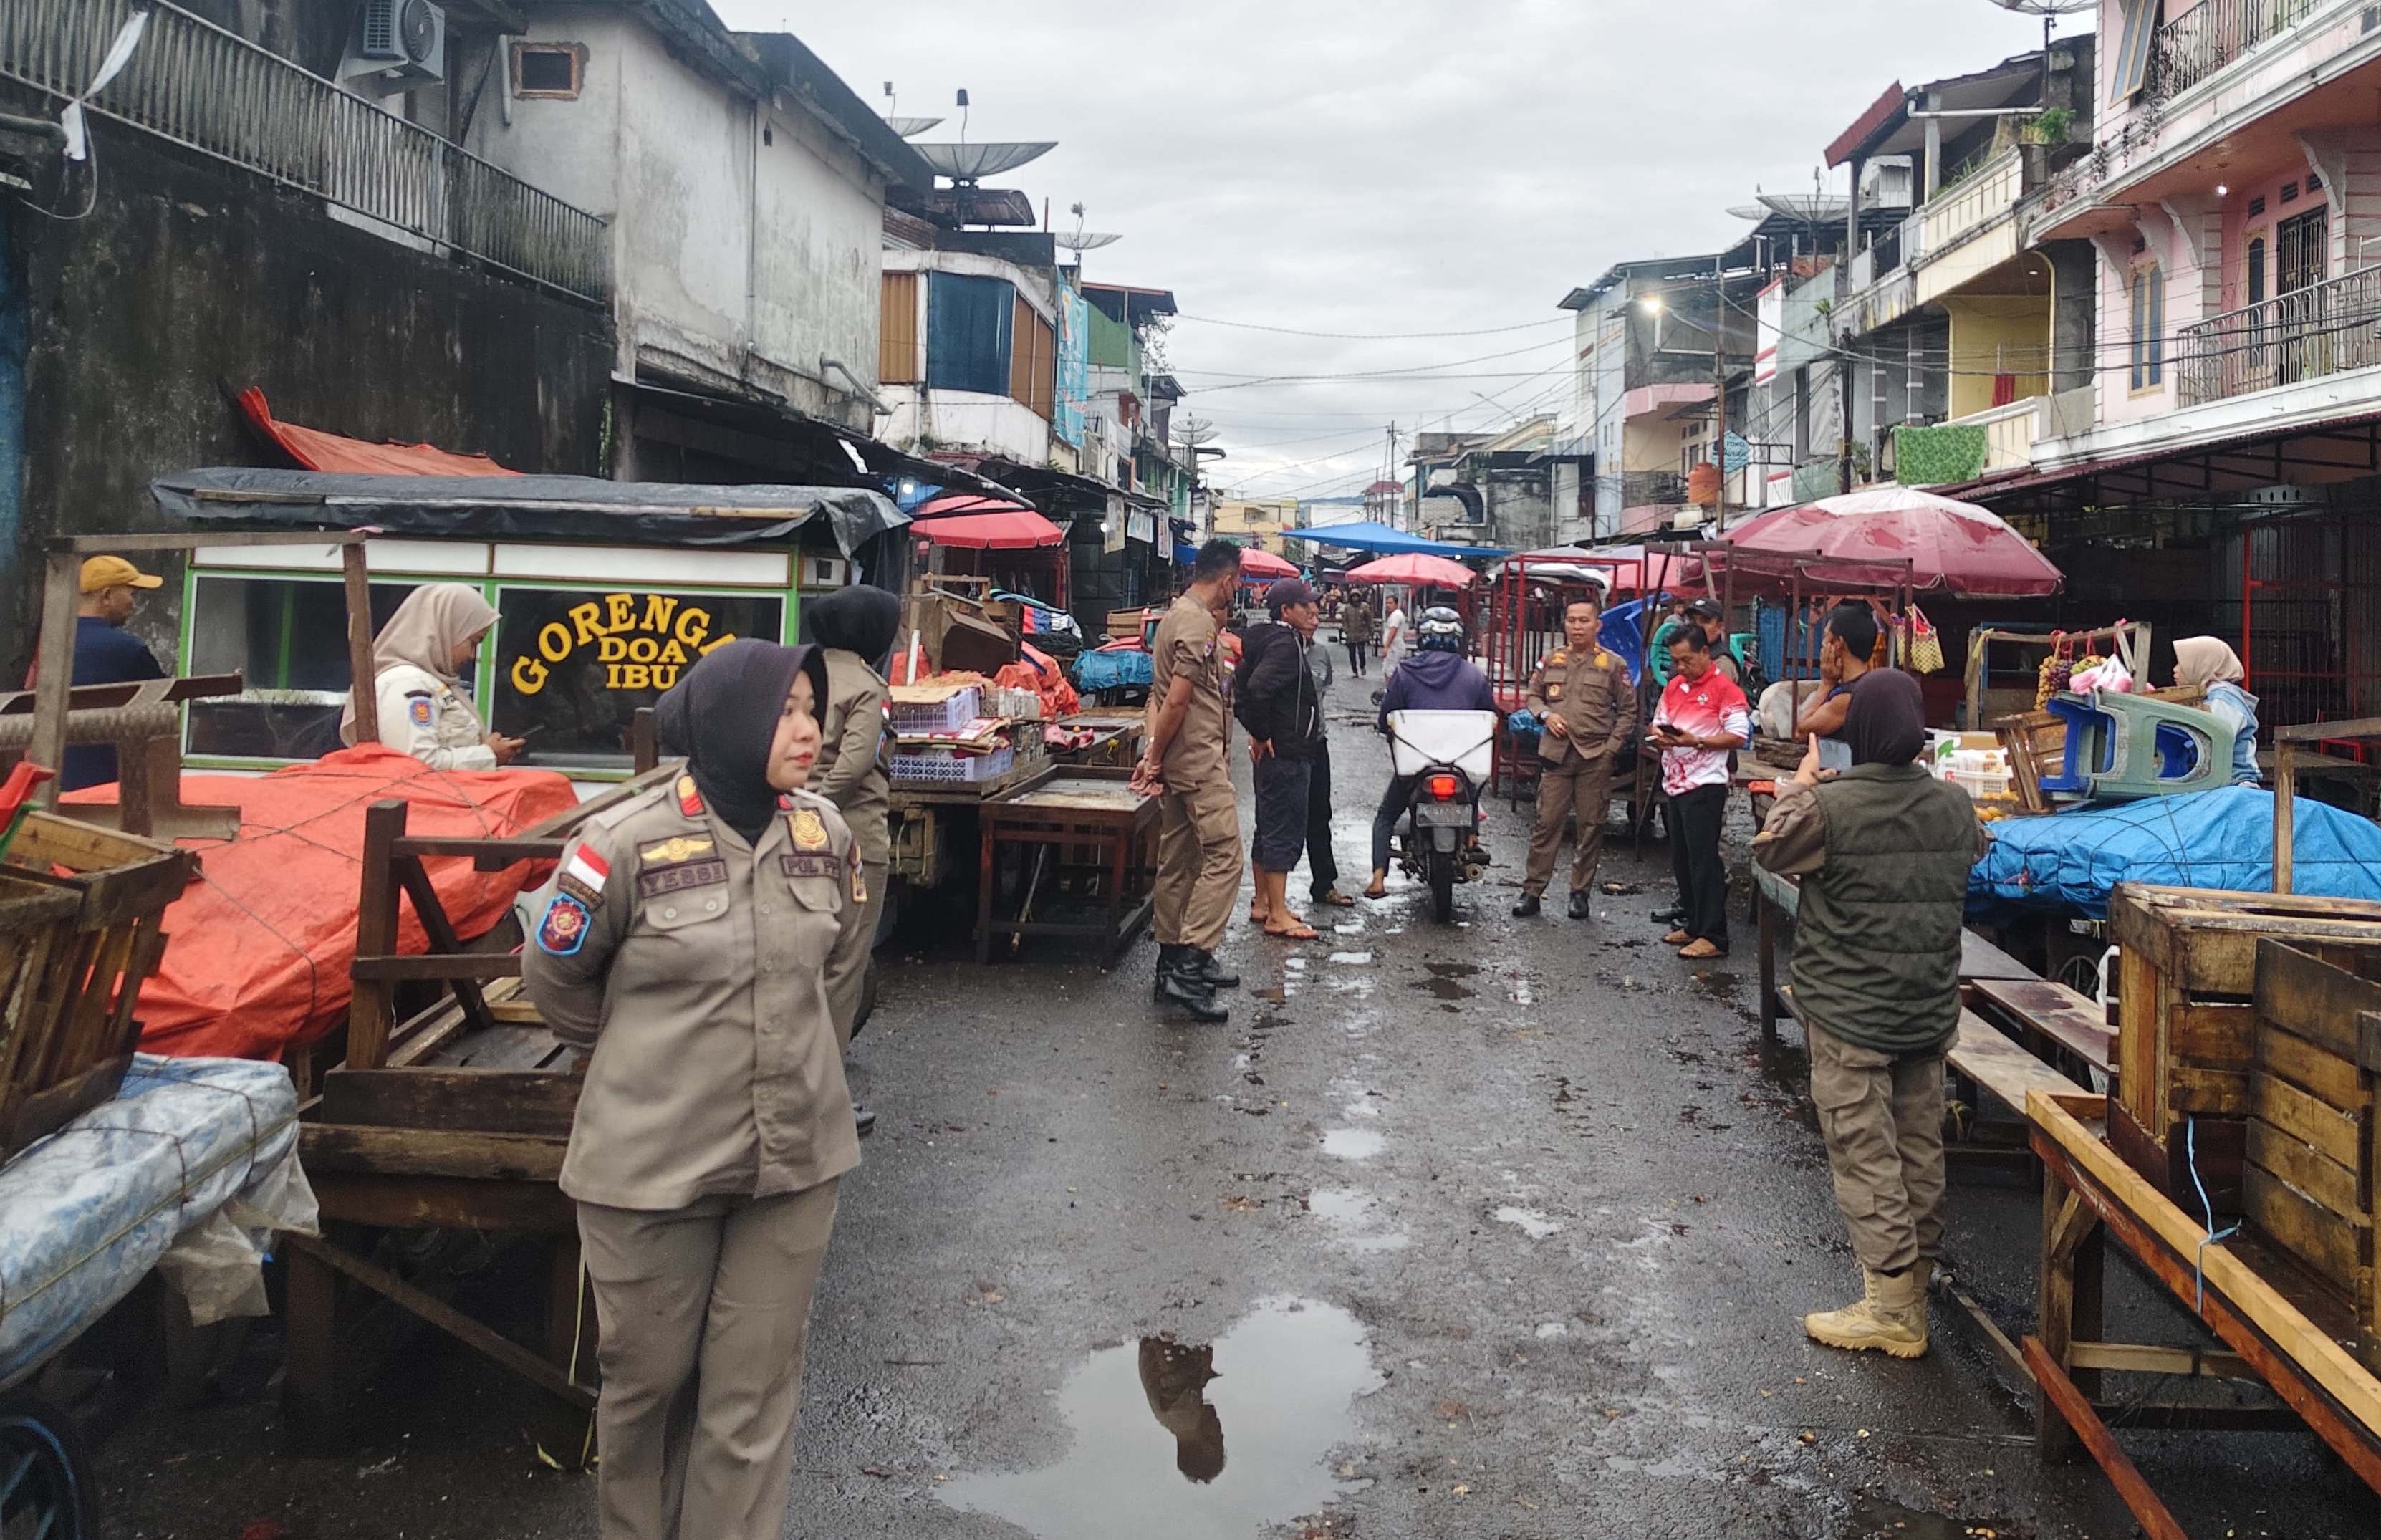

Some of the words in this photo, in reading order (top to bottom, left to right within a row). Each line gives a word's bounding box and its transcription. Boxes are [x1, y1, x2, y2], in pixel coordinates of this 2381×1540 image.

[597, 636, 688, 664] DOA
[605, 664, 680, 690] IBU
[643, 863, 723, 893] YESSI
